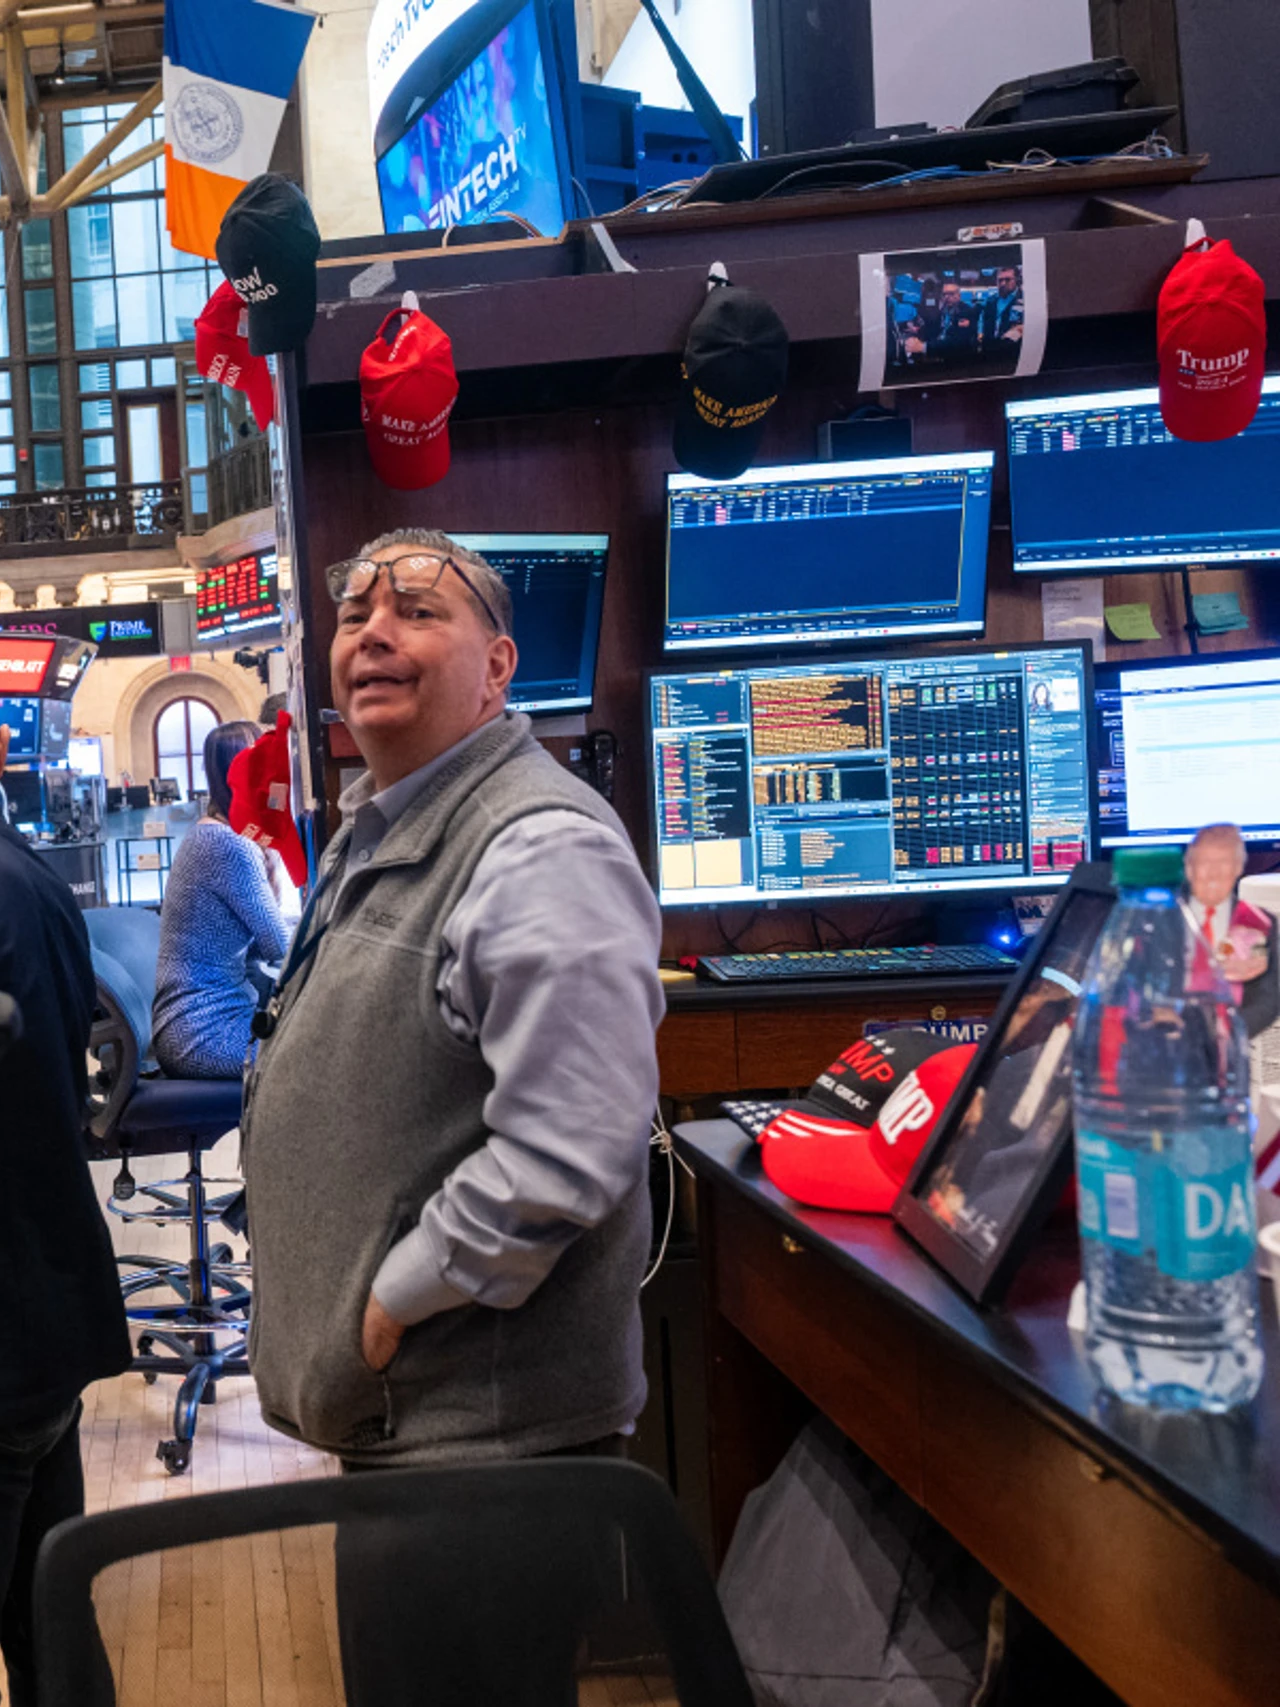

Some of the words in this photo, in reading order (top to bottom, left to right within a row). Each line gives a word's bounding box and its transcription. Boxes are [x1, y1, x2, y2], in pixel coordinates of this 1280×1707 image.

[427, 134, 518, 228] FINTECH
[231, 266, 262, 291] OW
[1176, 348, 1249, 371] Trump
[381, 414, 415, 432] MAKE
[383, 432, 423, 446] GREAT
[912, 1023, 988, 1042] UMP
